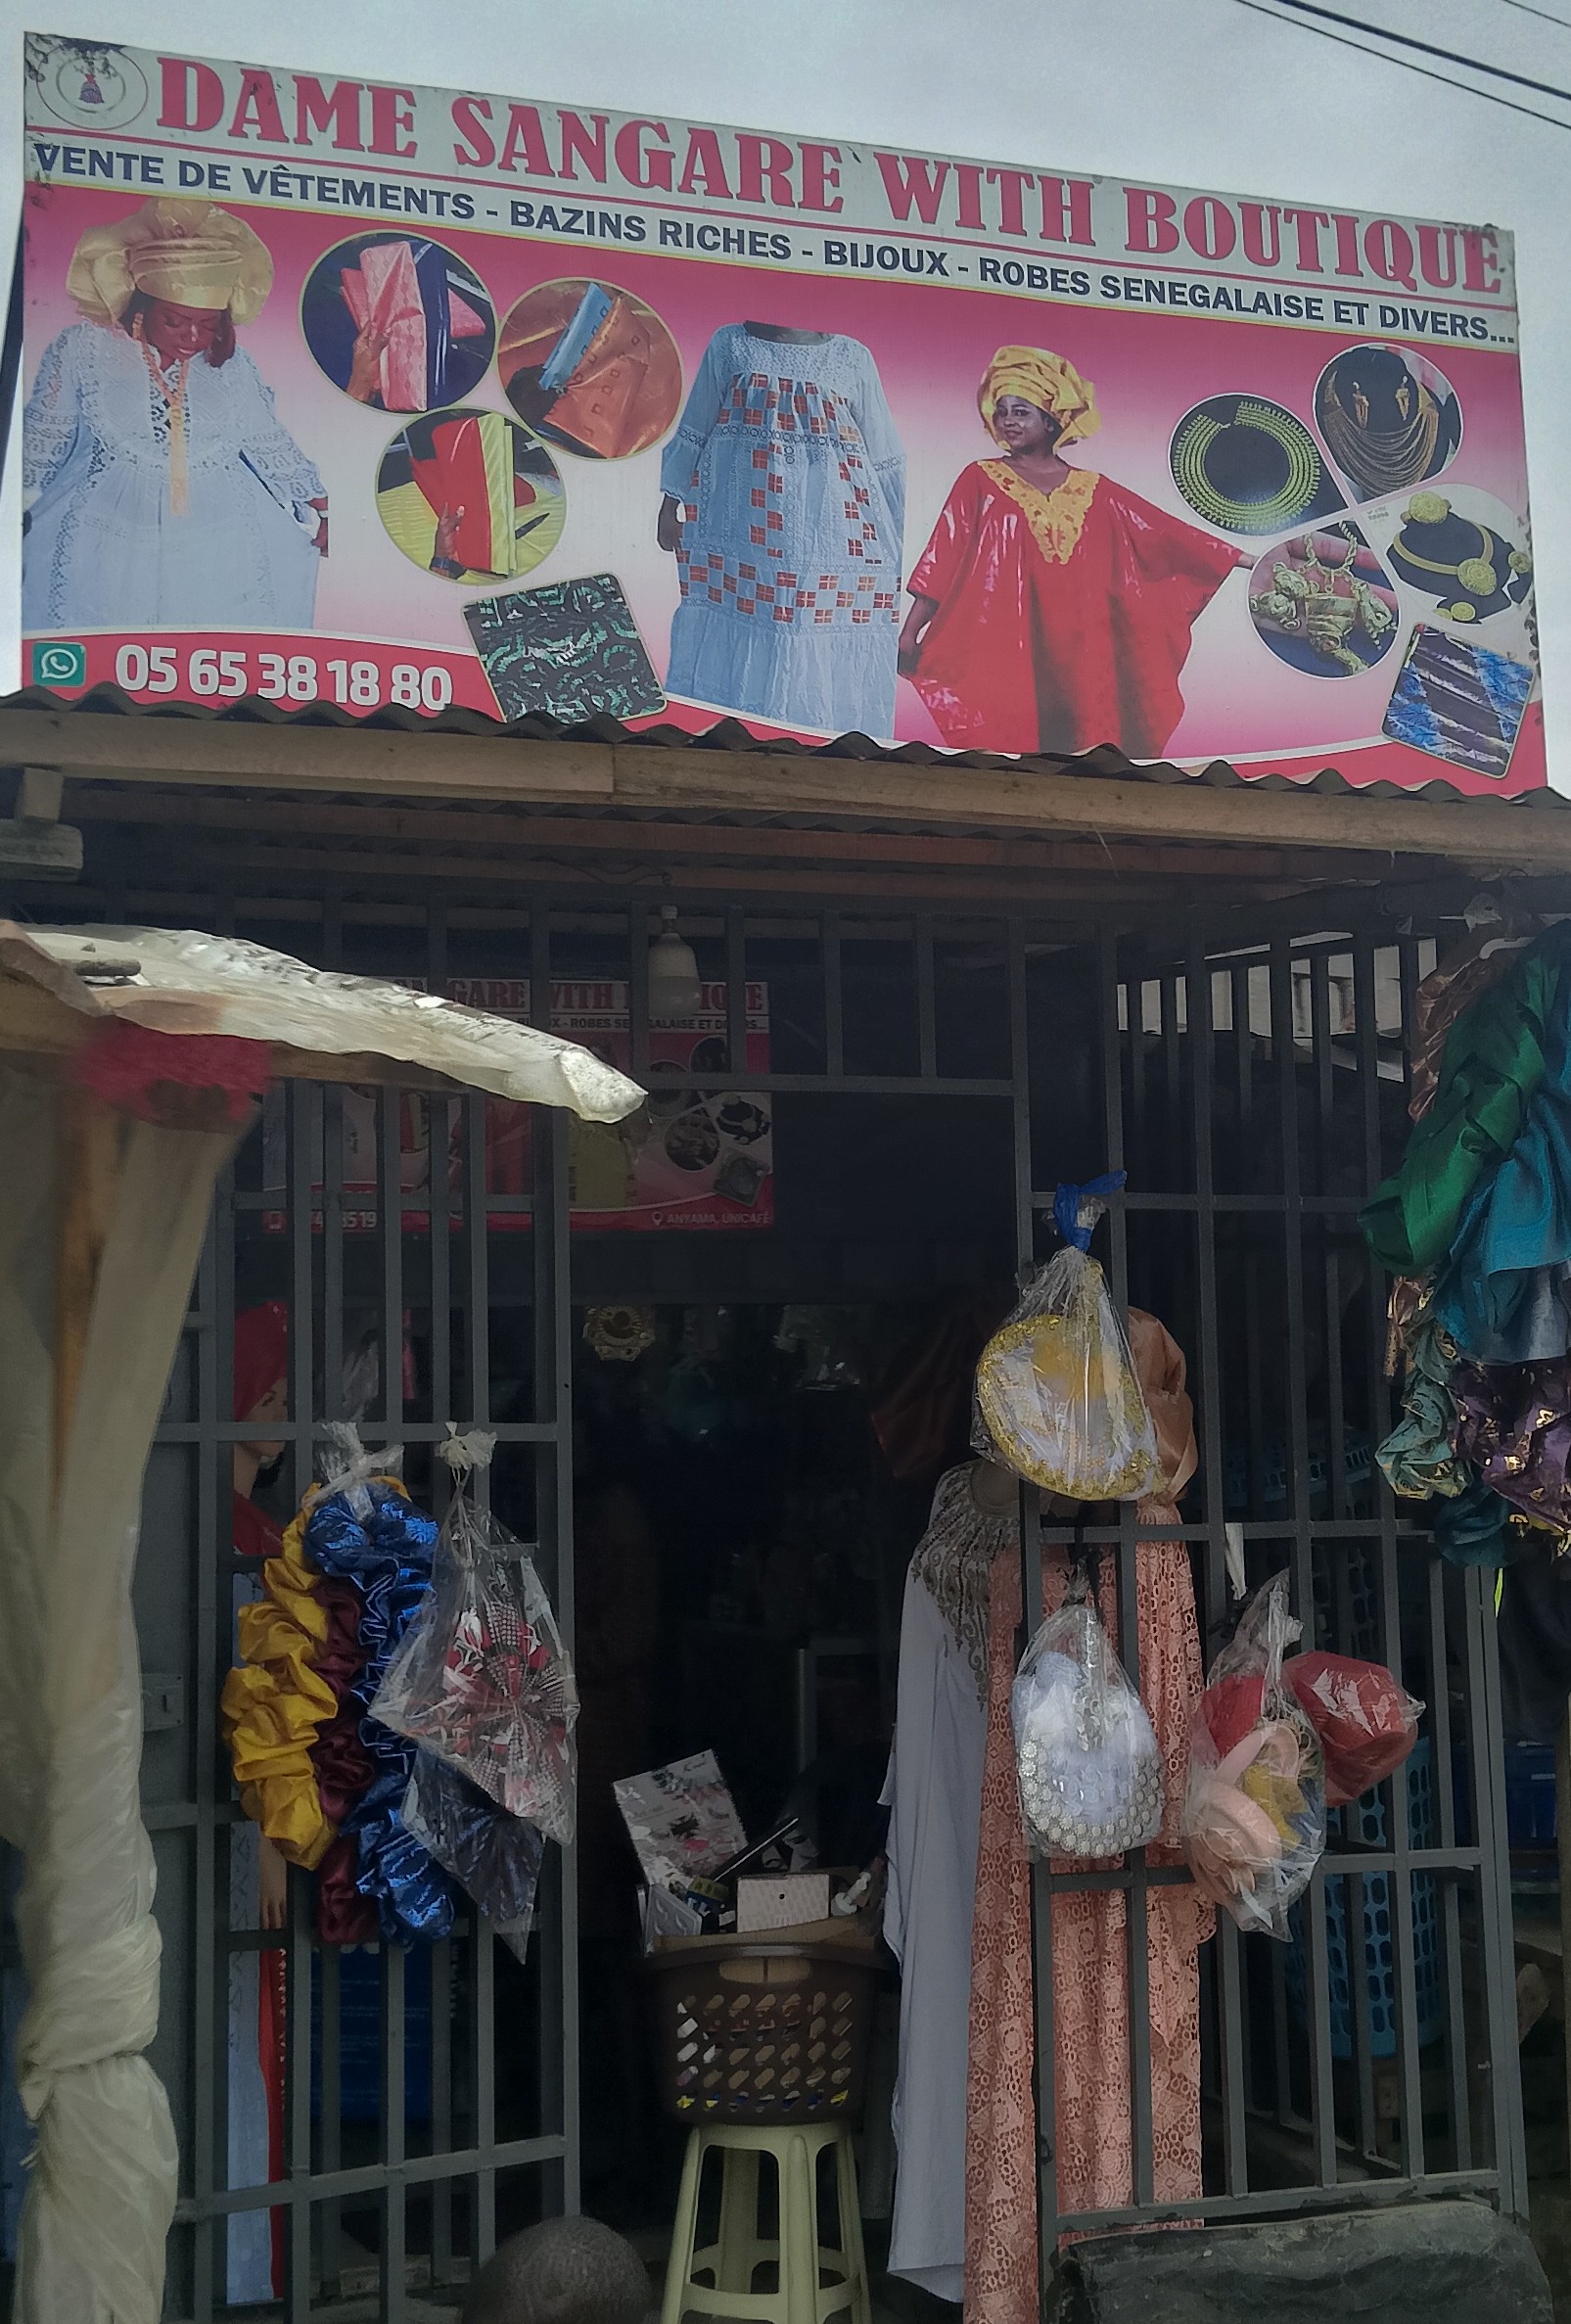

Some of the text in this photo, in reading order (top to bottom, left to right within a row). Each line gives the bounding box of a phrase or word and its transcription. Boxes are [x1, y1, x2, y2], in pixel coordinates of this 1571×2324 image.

[157, 57, 1502, 294] DAME SANGARE WITH BOUTIQUE
[33, 143, 163, 185] VENTE
[178, 160, 231, 192] DE
[242, 163, 475, 219] VÊTEMENTS
[511, 200, 646, 242] BAZINS
[659, 217, 791, 259] RICHES
[824, 240, 948, 277] BIJOUX
[979, 256, 1090, 295] ROBES
[1100, 275, 1323, 321] SENEGALAISE
[1334, 300, 1368, 324] ET
[1379, 305, 1514, 343] DIVERS...
[116, 644, 452, 711] 05 65 38 18 80
[571, 1018, 611, 1029] ROBES
